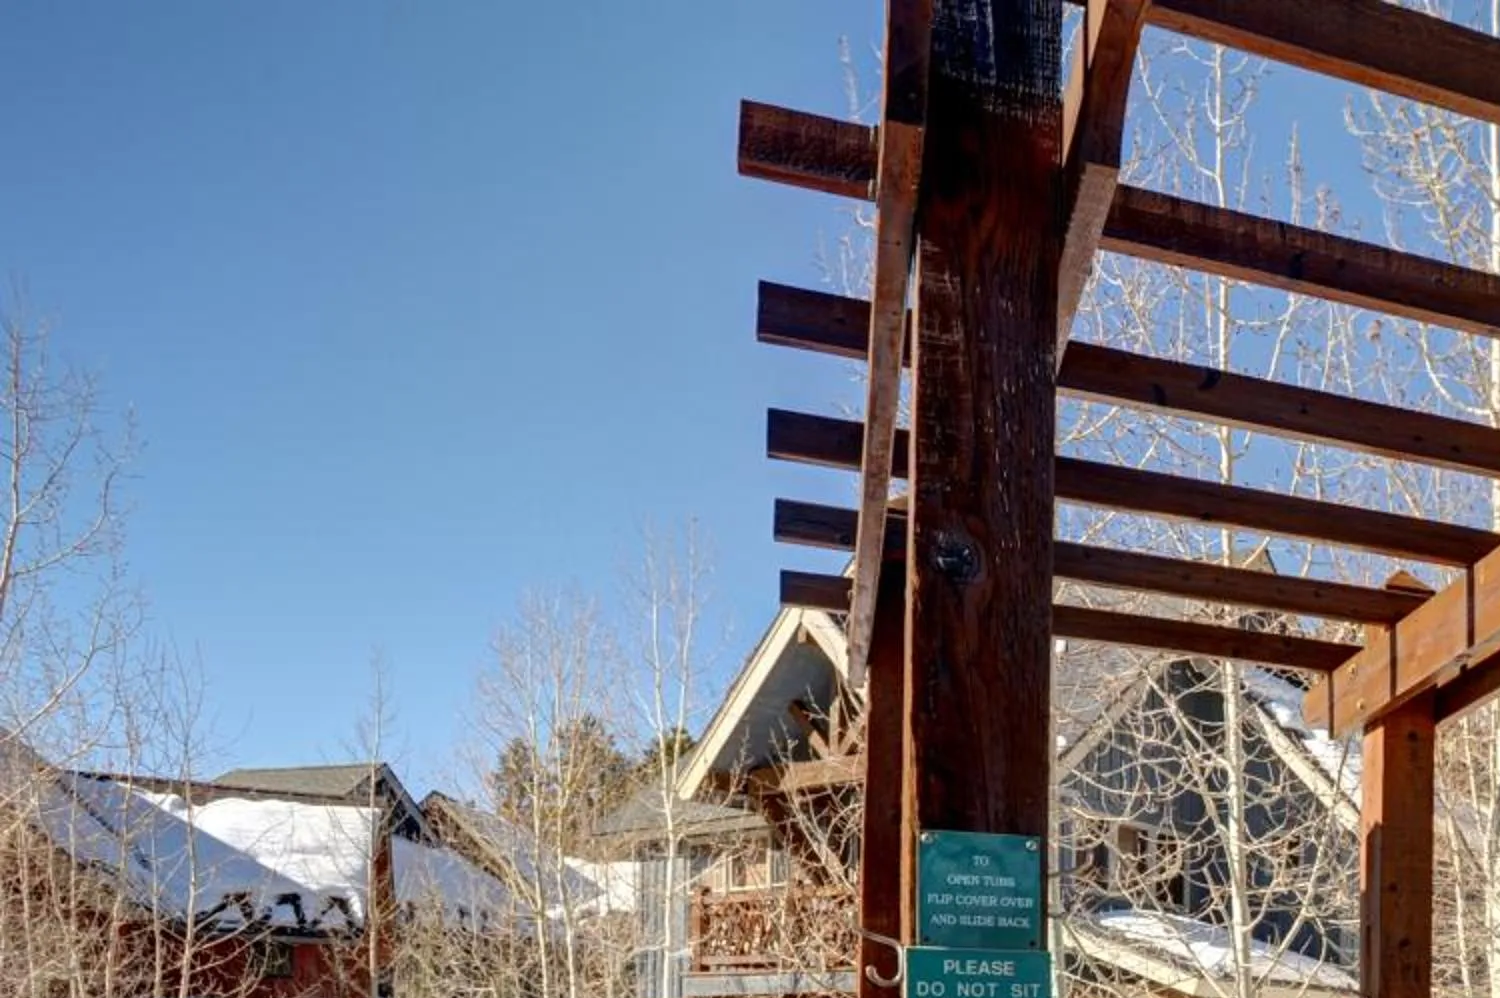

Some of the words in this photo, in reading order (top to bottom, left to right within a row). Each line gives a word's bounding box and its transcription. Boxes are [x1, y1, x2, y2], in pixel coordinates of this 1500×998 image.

[972, 855, 990, 866] TO
[947, 874, 979, 885] OPEN
[927, 893, 954, 904] FLIP
[956, 894, 998, 907] COVER
[1001, 897, 1033, 908] OVER
[931, 915, 957, 925] AND
[959, 916, 995, 927] SLIDE
[998, 917, 1030, 928] BACK
[943, 960, 1015, 975] PLEASE
[916, 982, 945, 996] DO
[957, 982, 998, 997] NOT
[1011, 983, 1041, 998] SIT
